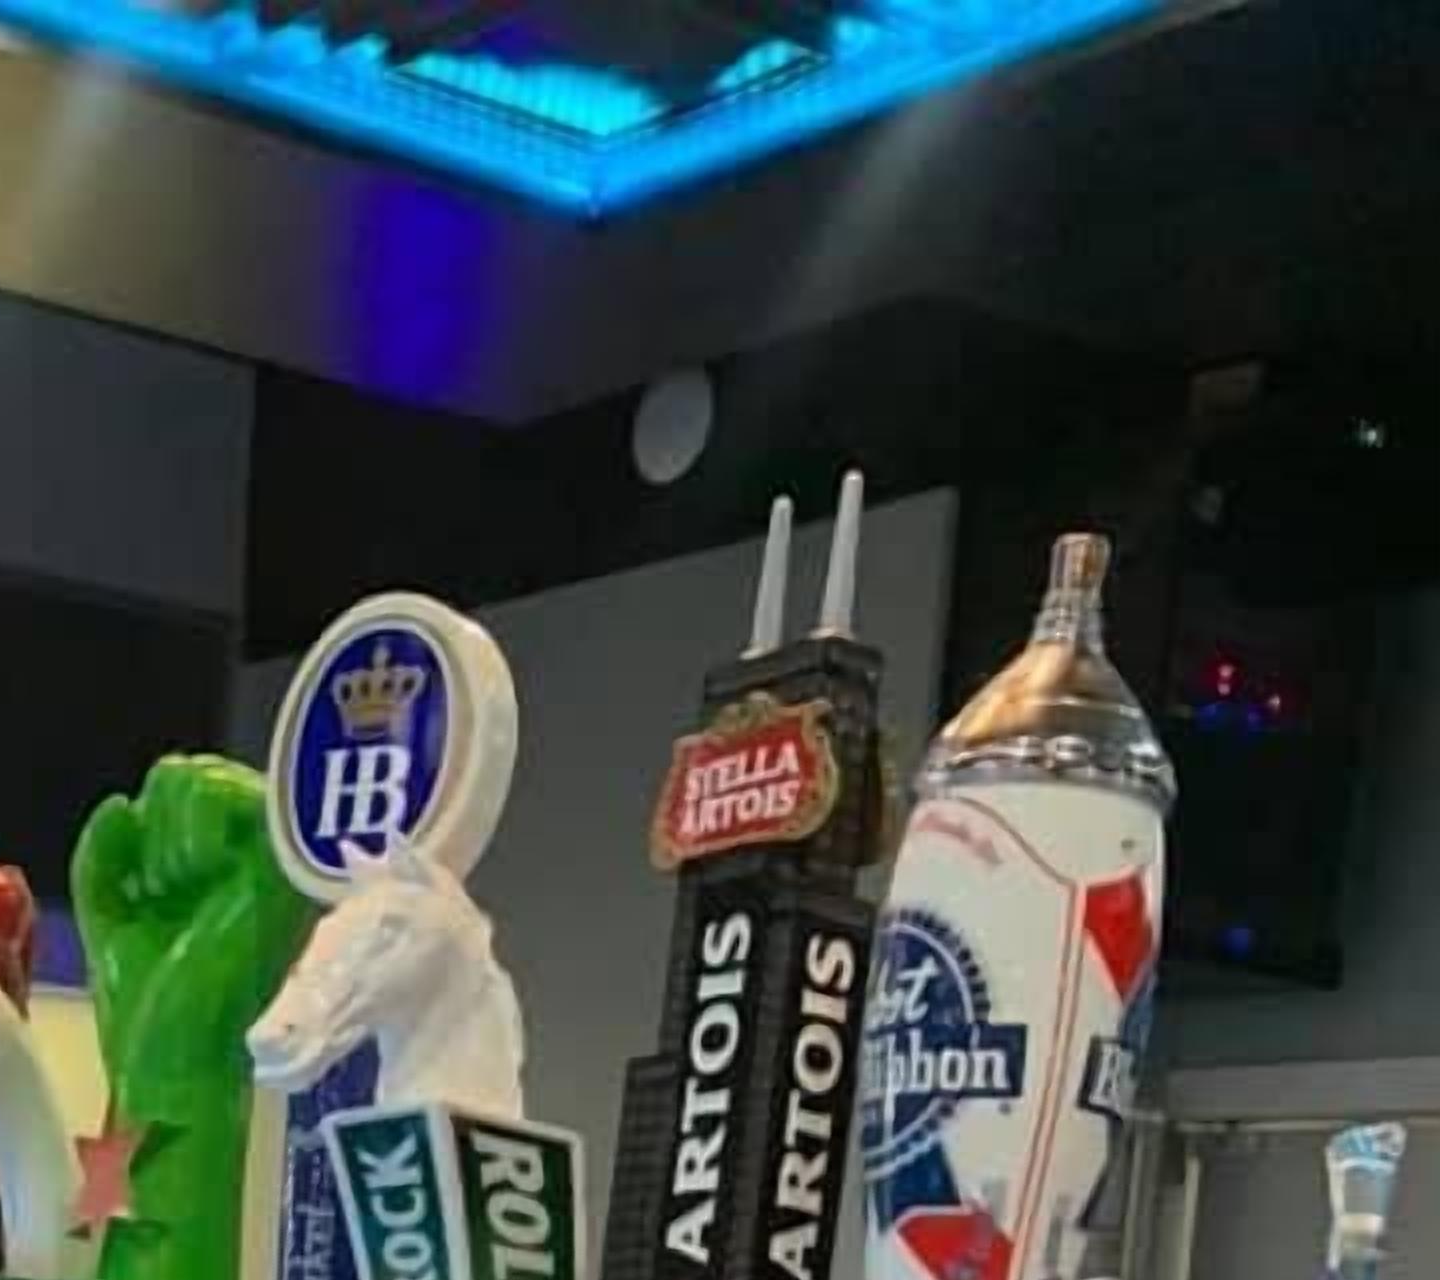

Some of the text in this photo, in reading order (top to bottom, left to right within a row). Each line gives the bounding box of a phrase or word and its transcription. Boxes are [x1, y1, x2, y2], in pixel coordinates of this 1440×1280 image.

[314, 745, 411, 838] HB
[679, 779, 800, 834] ARTOIS
[685, 741, 800, 801] STELLA
[665, 911, 753, 1264] ARTOIS
